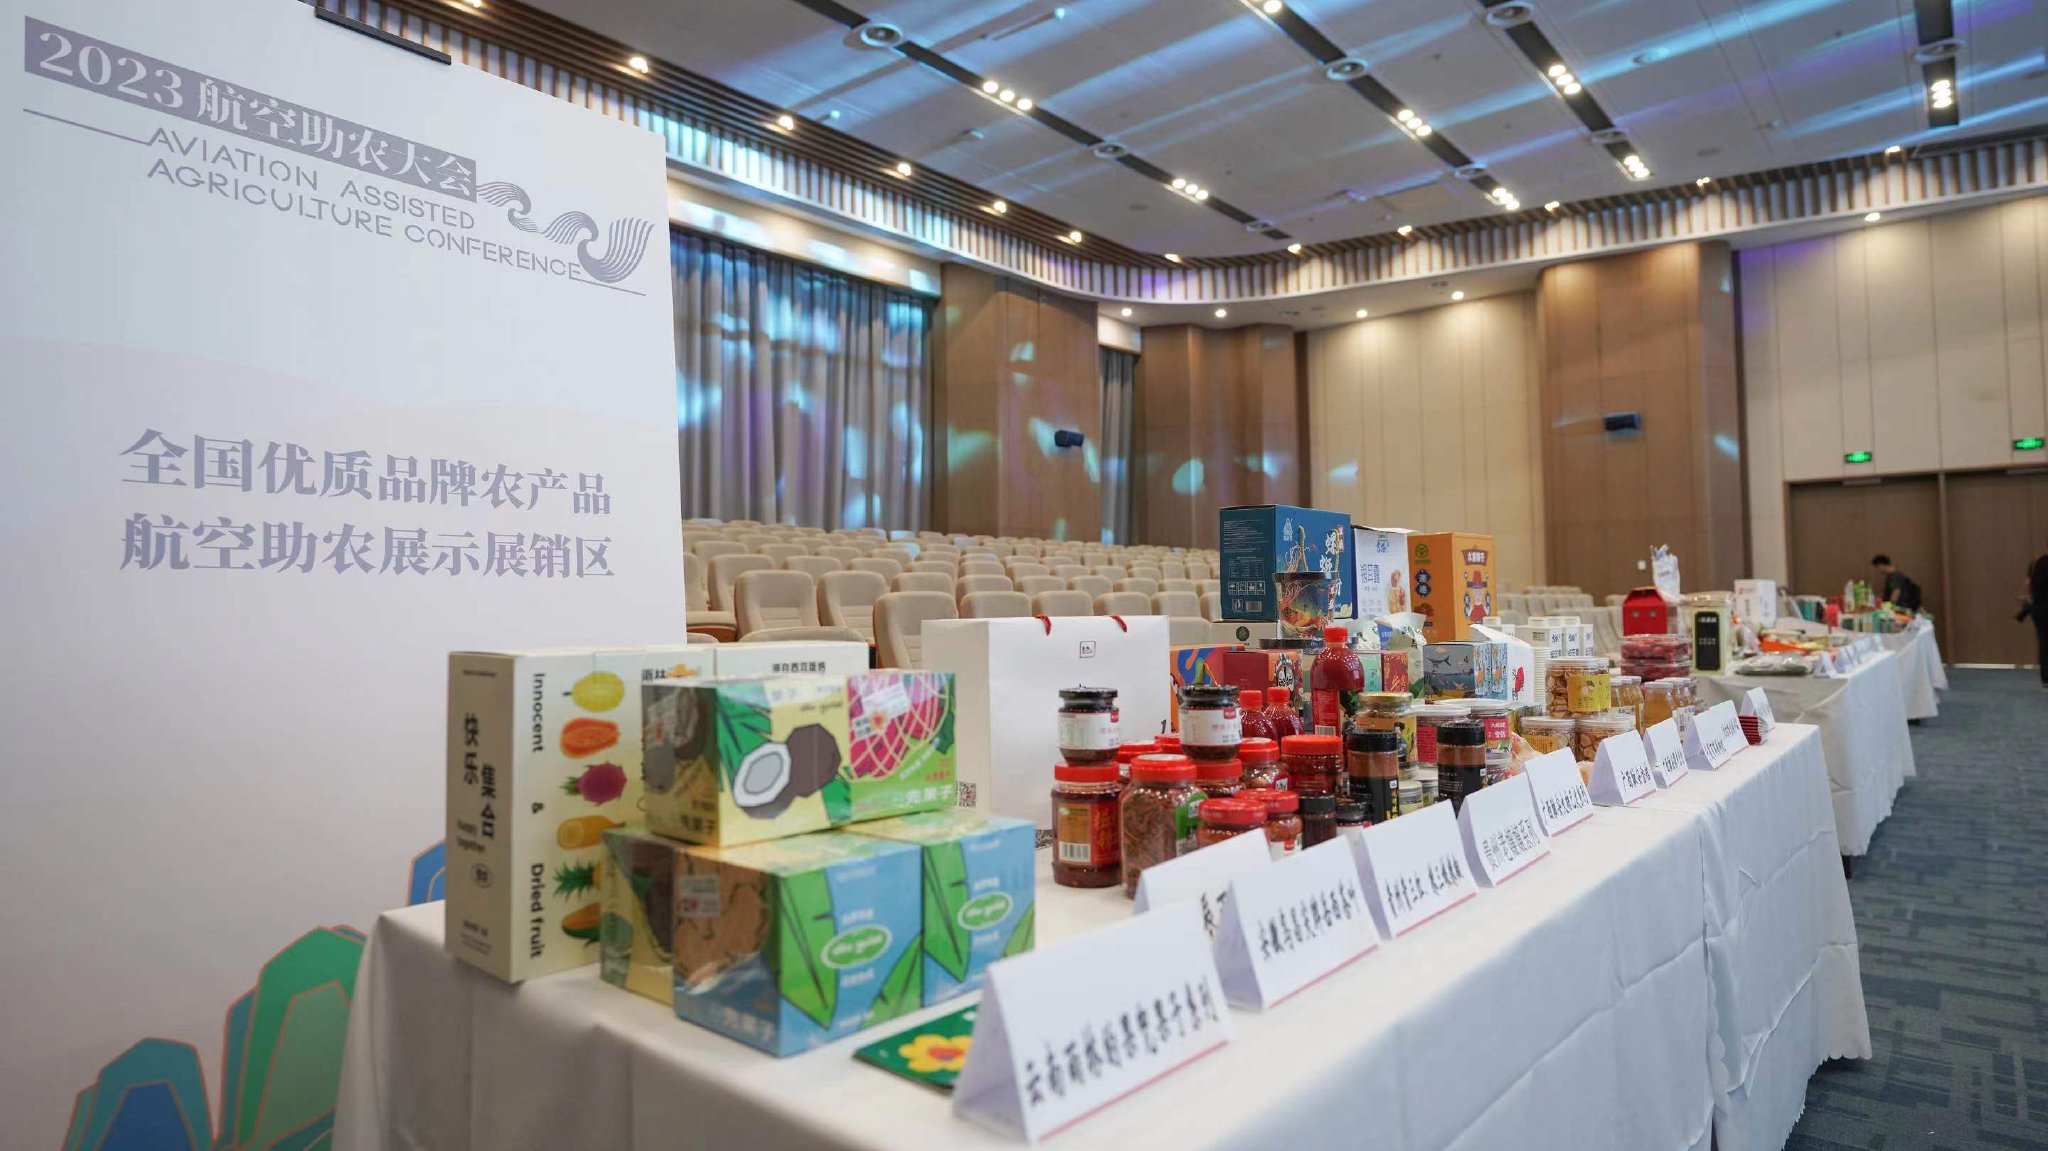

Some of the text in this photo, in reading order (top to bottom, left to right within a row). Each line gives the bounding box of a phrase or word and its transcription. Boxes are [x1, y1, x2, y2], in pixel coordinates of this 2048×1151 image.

[38, 31, 473, 199] 2023 航空助农大会
[147, 158, 583, 281] AGRICULTURE CONFERENCE
[150, 127, 476, 231] AVIATION ASSISTED
[118, 428, 612, 515] 全国优质品牌农产品
[119, 511, 615, 579] 航空助农展示展销区
[529, 672, 546, 959] Innocent & Dried fruit
